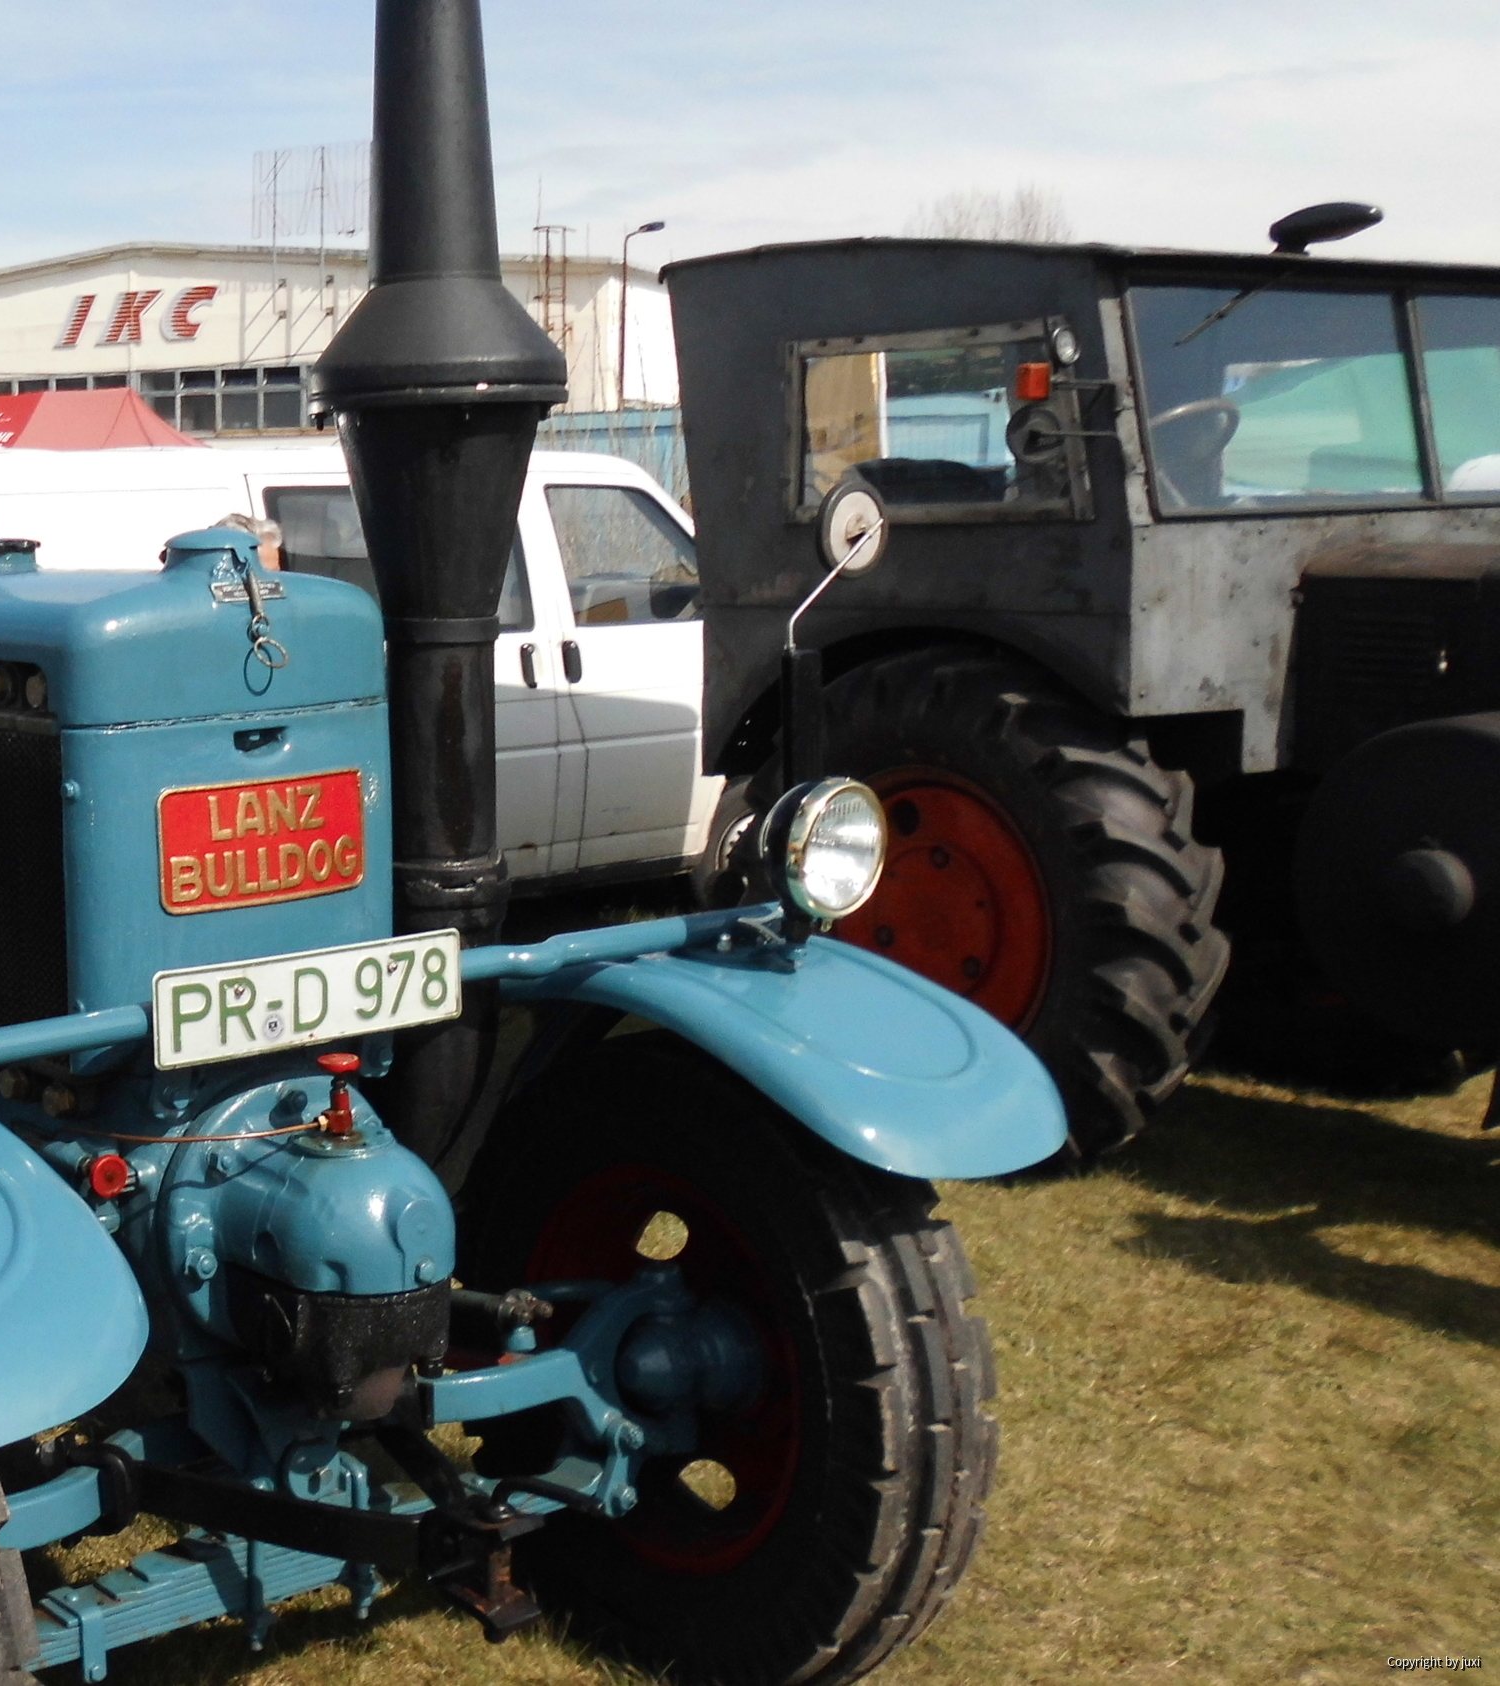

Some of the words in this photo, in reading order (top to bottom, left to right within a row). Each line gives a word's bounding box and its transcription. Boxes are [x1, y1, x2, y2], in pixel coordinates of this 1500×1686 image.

[52, 285, 219, 349] IKC
[208, 784, 325, 841] LANZ
[170, 834, 357, 903] BULLDOG
[354, 947, 449, 1021] 978
